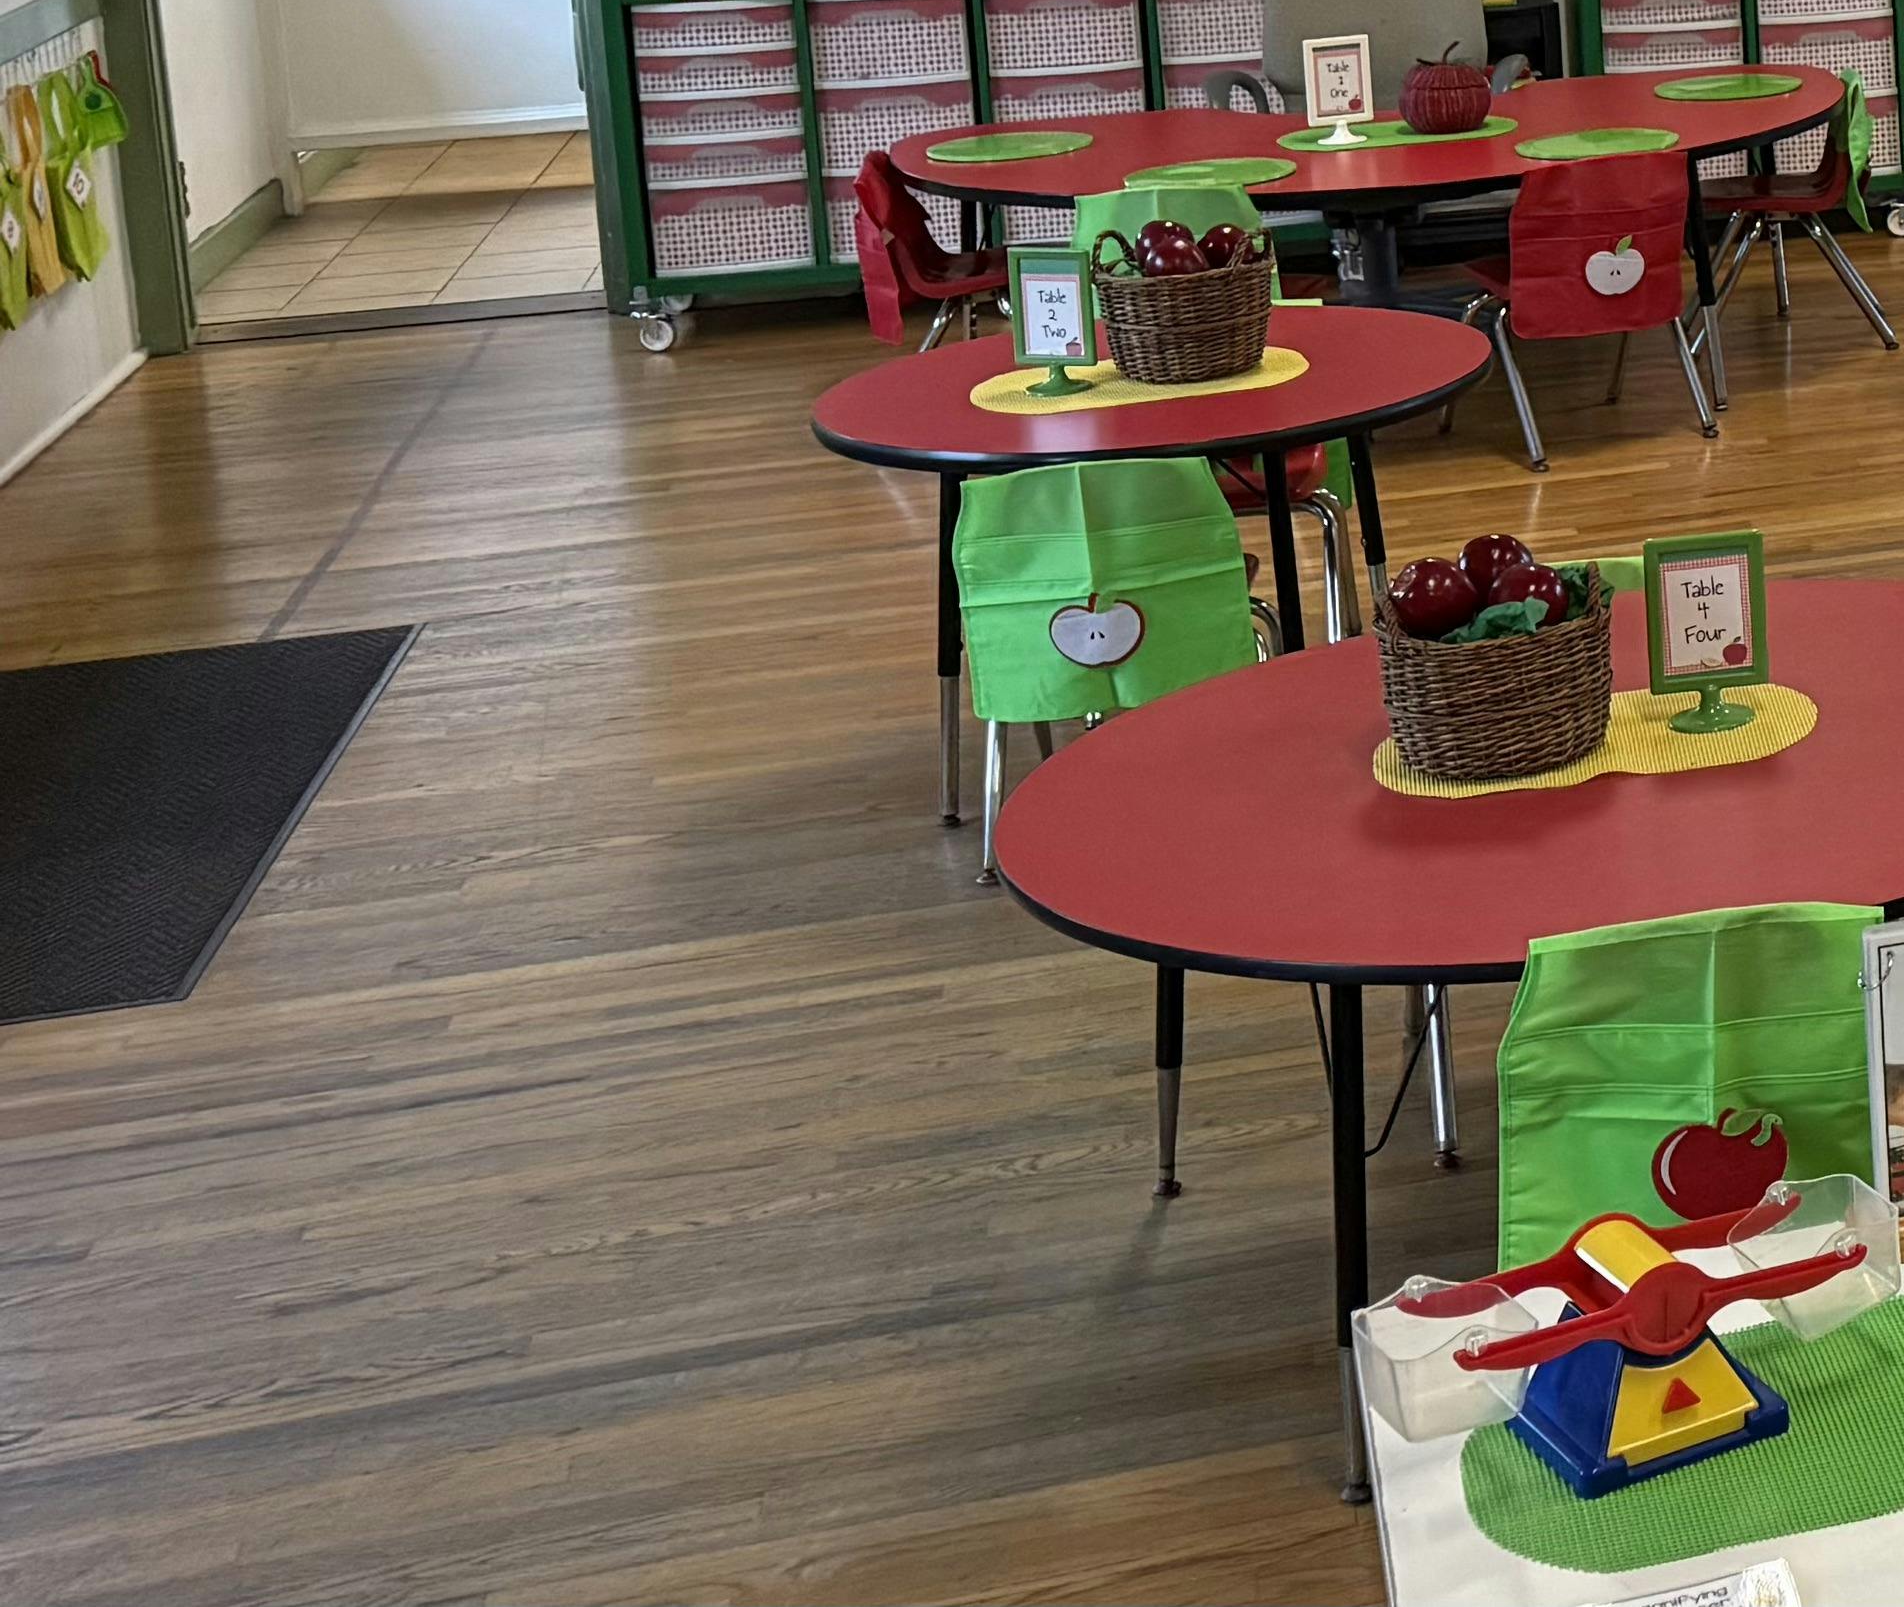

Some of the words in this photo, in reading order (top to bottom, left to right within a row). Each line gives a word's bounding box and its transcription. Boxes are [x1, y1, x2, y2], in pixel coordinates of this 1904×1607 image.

[1038, 288, 1067, 305] Table
[1048, 309, 1057, 321] 2
[1042, 325, 1067, 339] Two
[1681, 579, 1725, 599] Table
[1697, 602, 1709, 619] 4
[1685, 626, 1728, 644] Four
